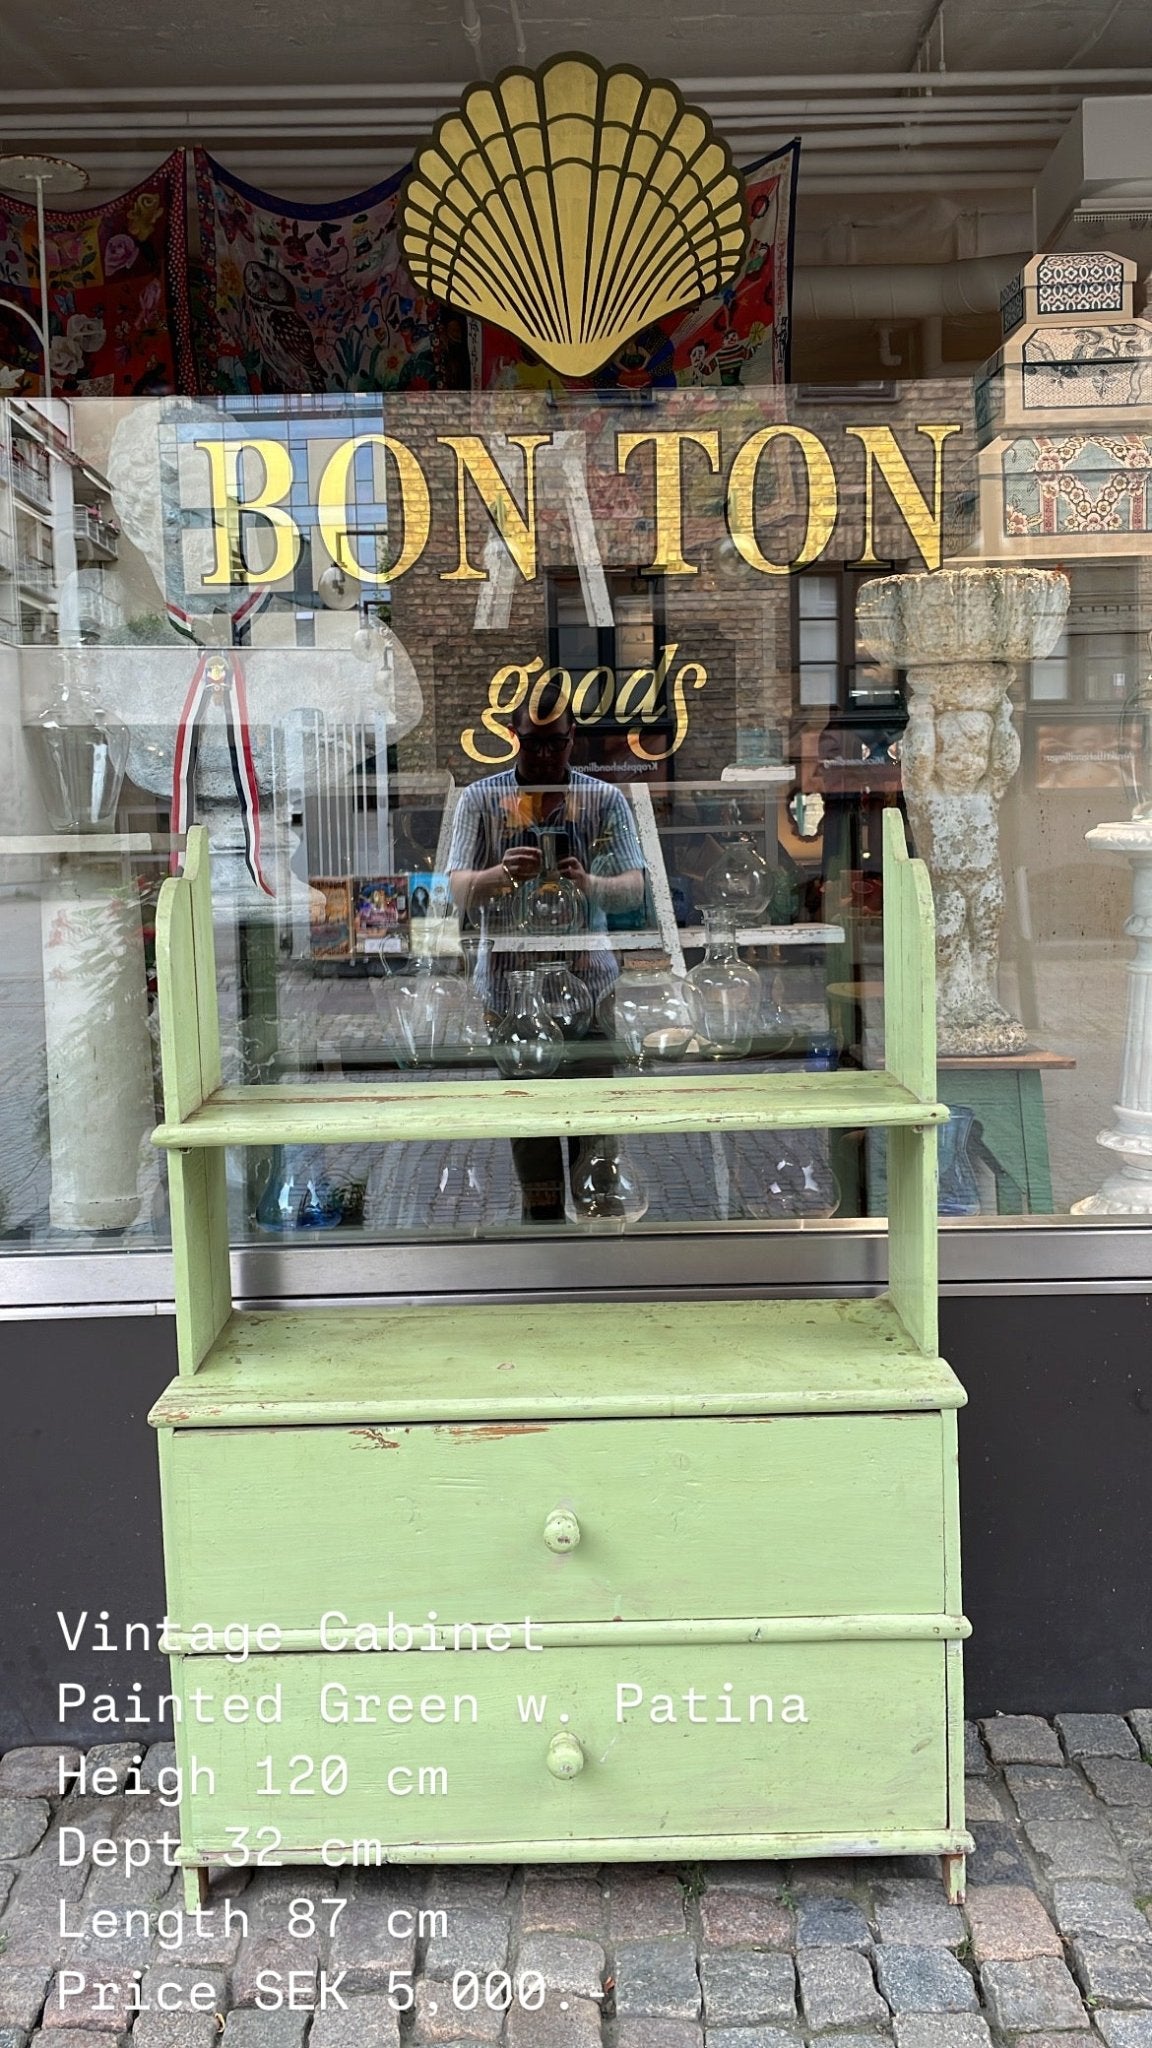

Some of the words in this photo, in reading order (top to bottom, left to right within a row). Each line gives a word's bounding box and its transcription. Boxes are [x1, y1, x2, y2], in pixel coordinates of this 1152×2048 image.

[194, 433, 553, 584] BON
[616, 423, 962, 577] TON
[460, 642, 708, 765] goods
